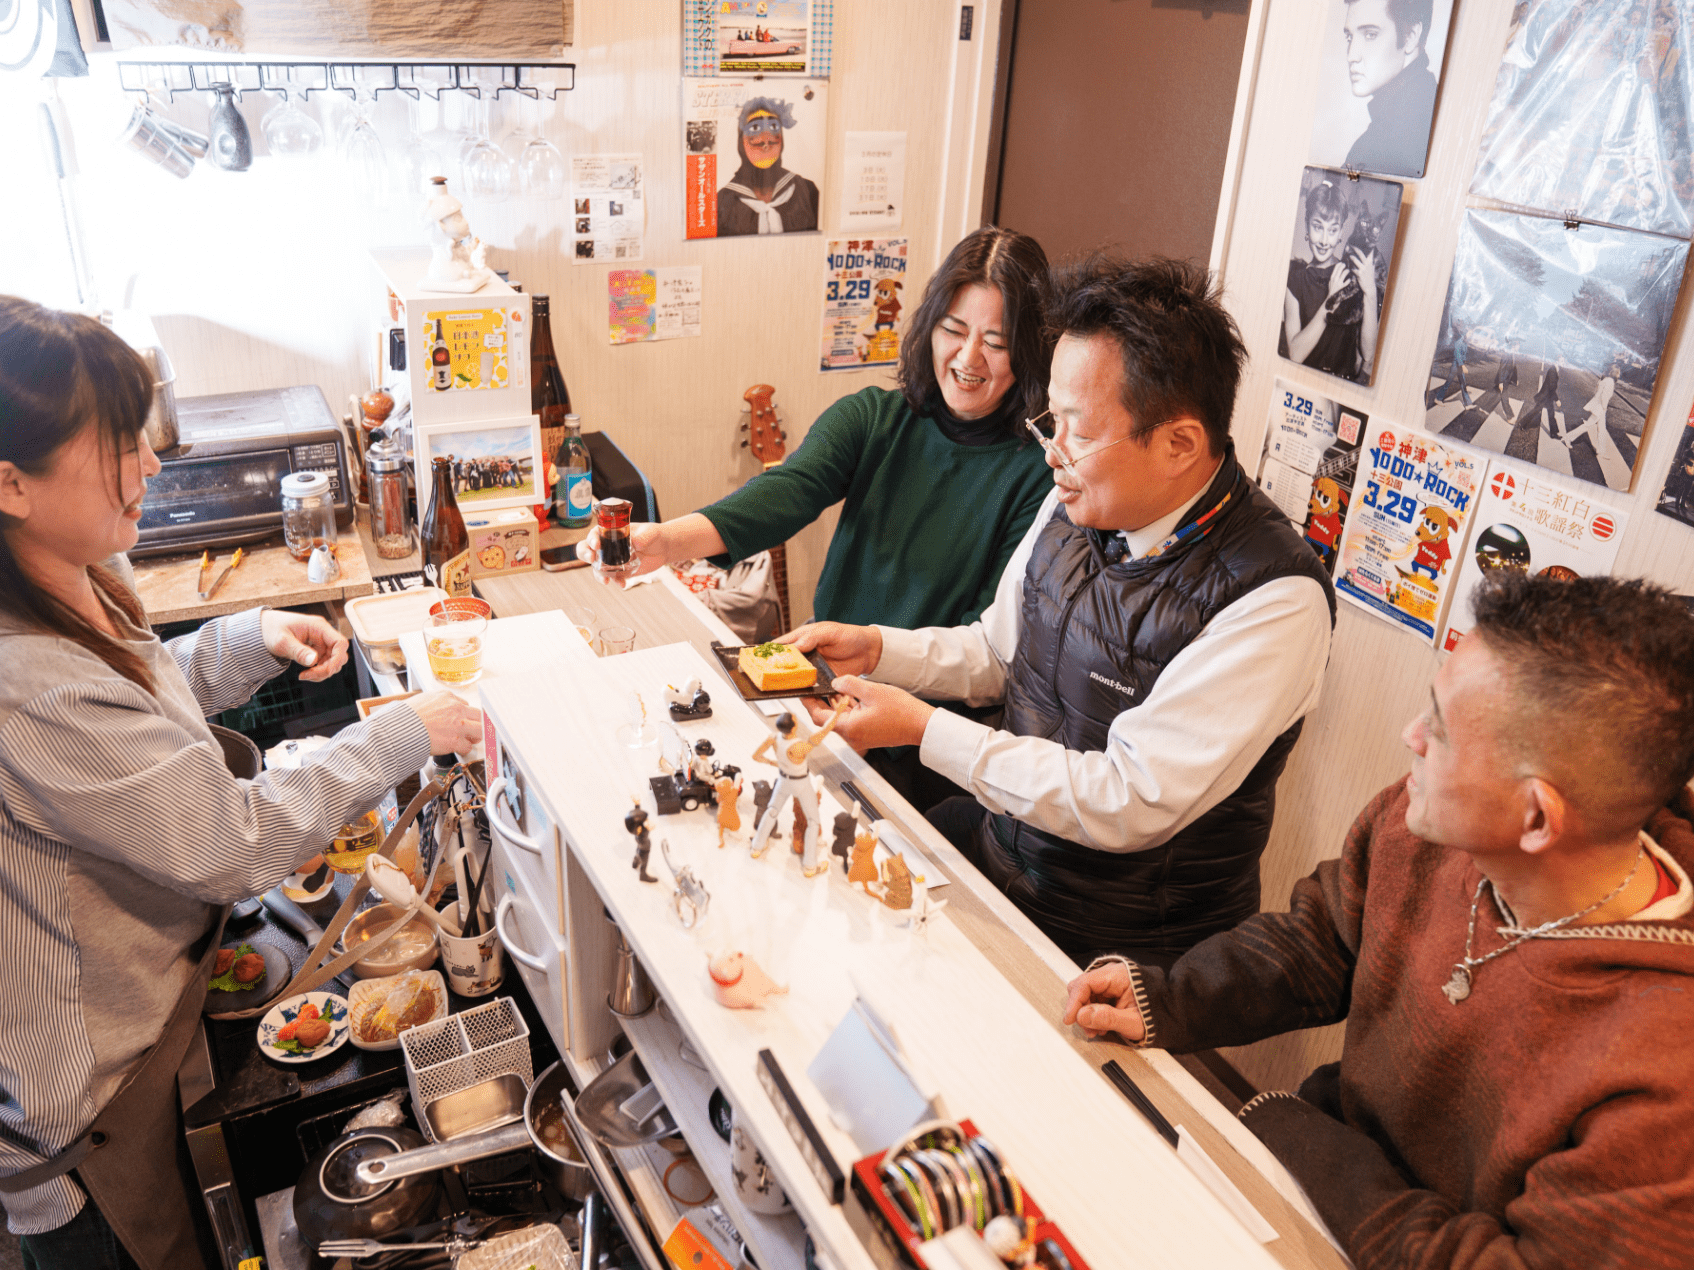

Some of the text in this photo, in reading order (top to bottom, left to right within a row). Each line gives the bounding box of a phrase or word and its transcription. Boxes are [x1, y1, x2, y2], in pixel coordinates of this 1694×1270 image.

[827, 280, 871, 301] 3.29
[1283, 391, 1313, 416] 3.29
[1398, 441, 1428, 464] 神津
[1454, 460, 1474, 470] VOL.5
[1363, 480, 1418, 525] 3.29
[1519, 478, 1591, 521] 十三紅白
[1535, 508, 1585, 541] 歌謡祭
